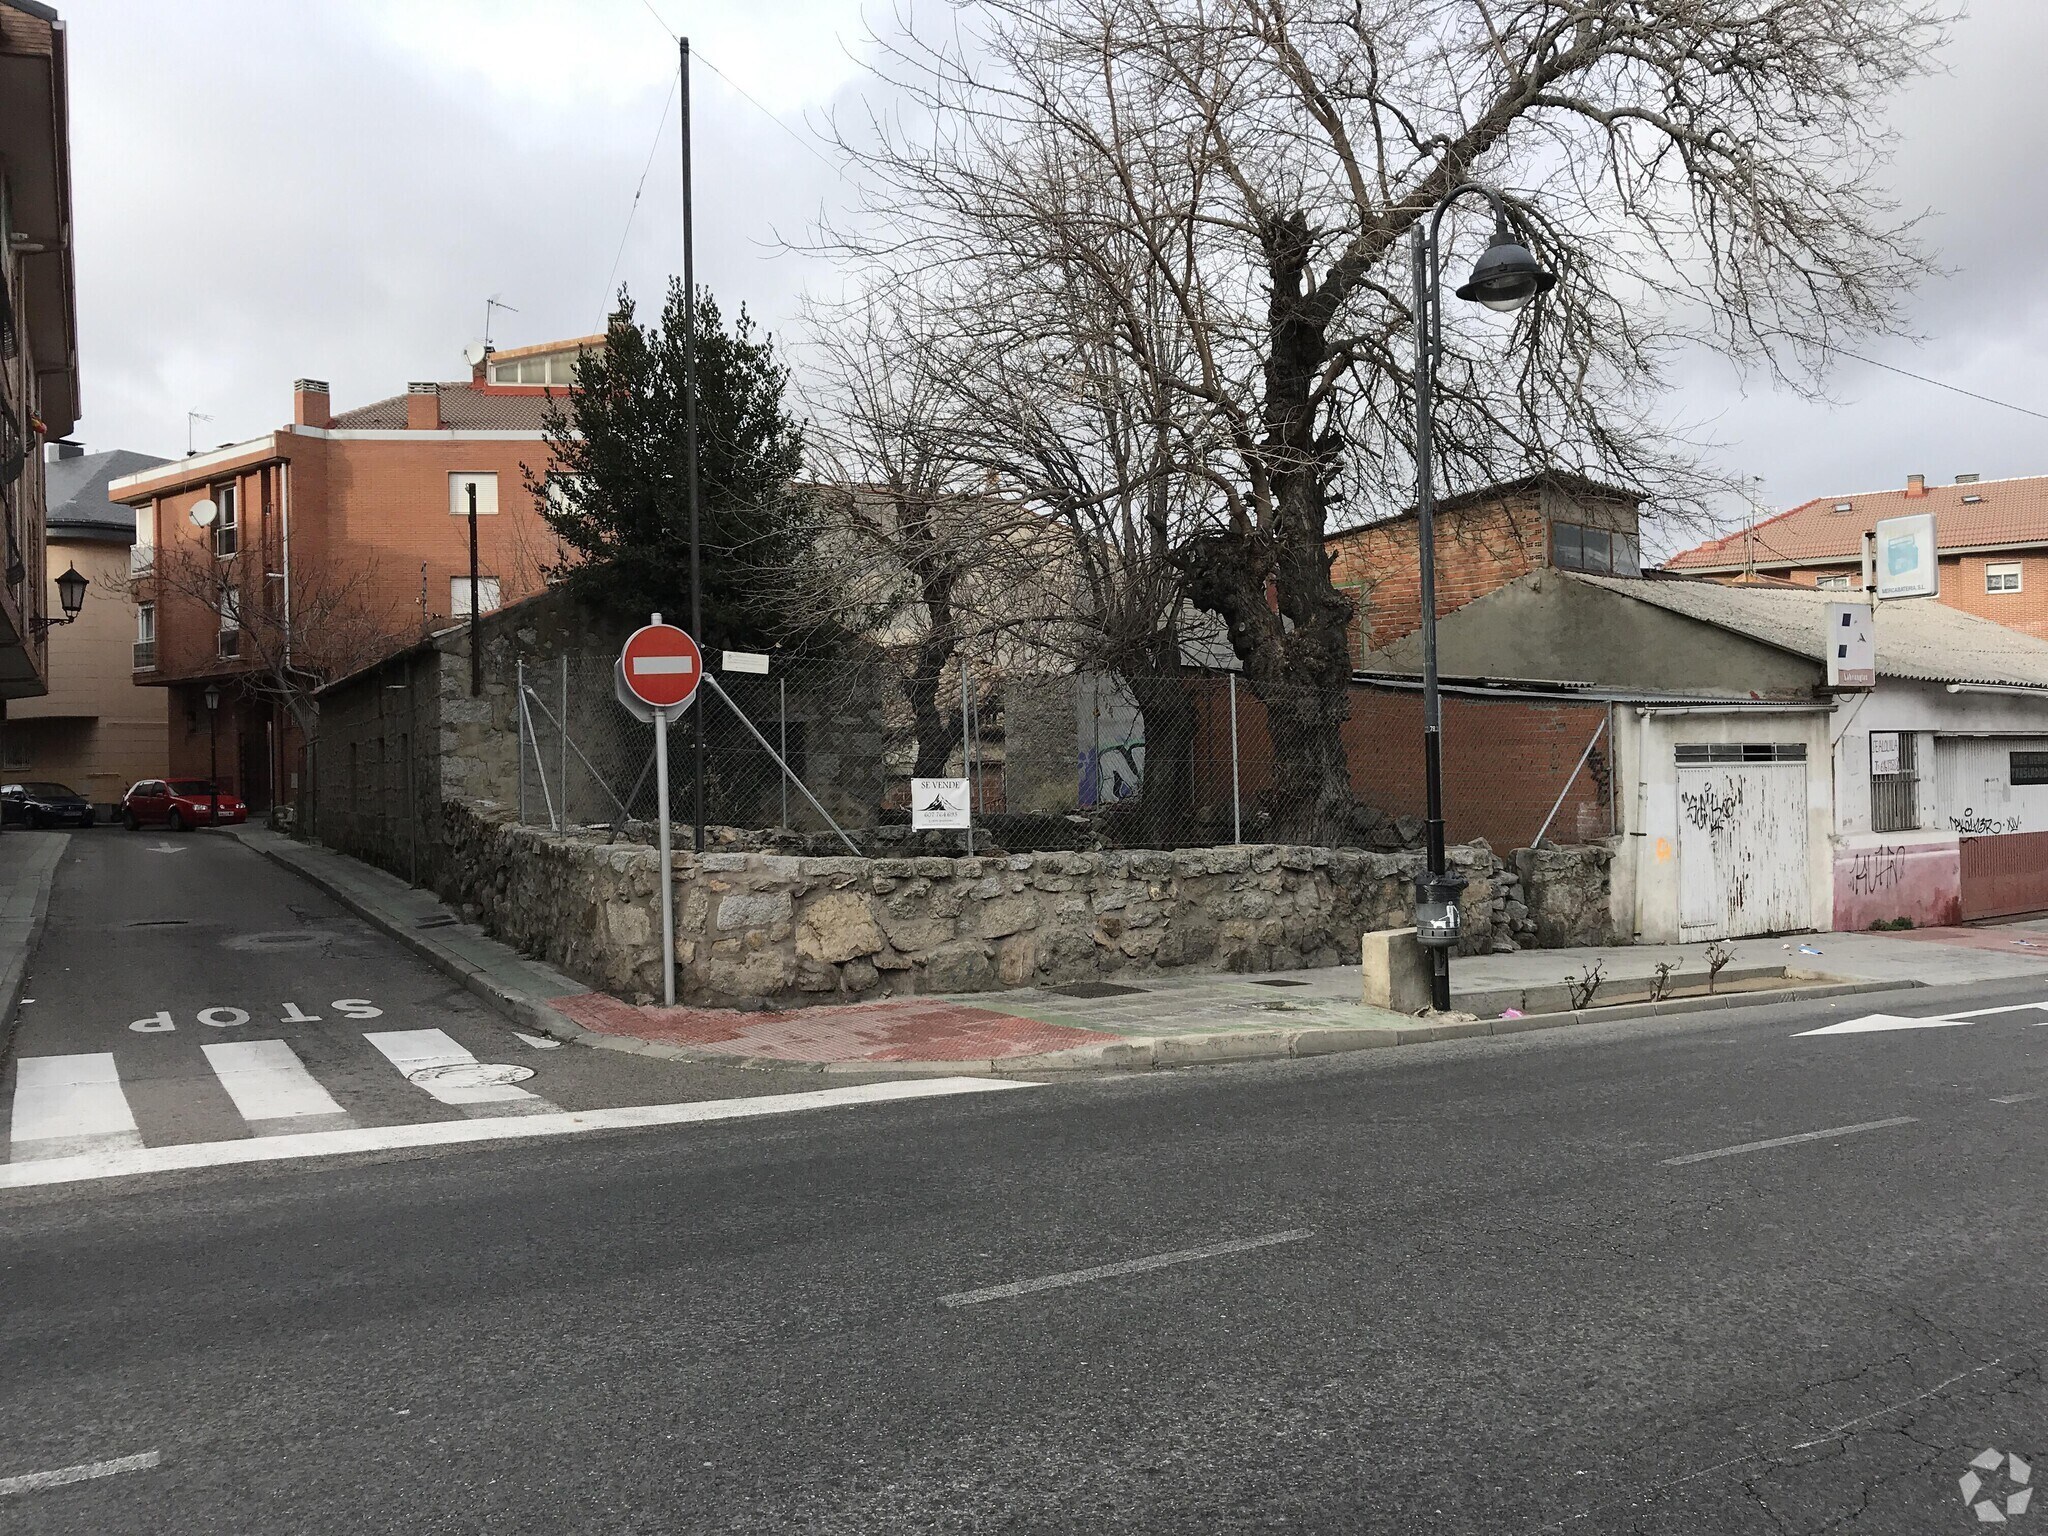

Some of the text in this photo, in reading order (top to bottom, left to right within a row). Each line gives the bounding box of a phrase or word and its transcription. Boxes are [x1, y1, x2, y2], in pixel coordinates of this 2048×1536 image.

[921, 781, 960, 789] SE VENDE
[128, 998, 384, 1033] STOP
